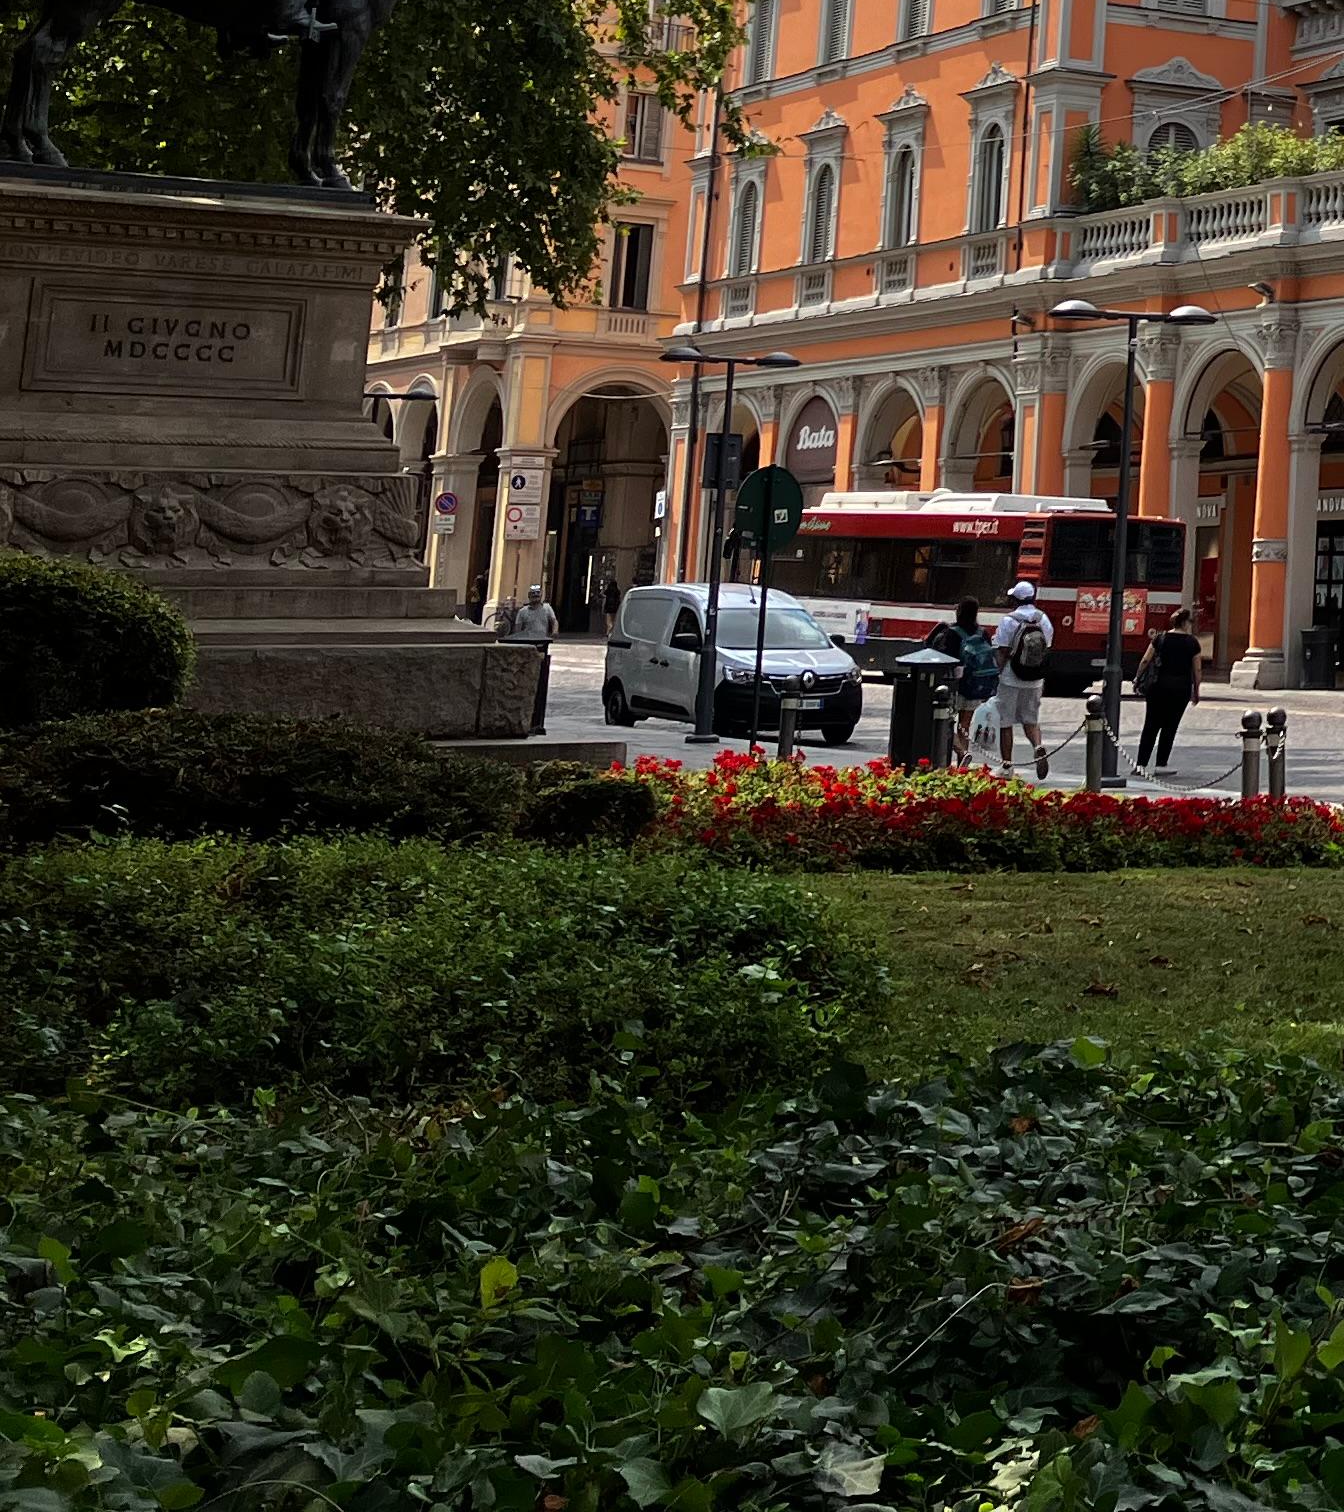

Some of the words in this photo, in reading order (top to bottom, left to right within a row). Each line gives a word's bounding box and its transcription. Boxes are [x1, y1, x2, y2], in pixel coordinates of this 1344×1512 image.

[127, 316, 252, 340] GIVGNO
[103, 339, 236, 363] MDCCCC
[796, 425, 835, 450] Bata
[952, 518, 999, 538] www.tper.it
